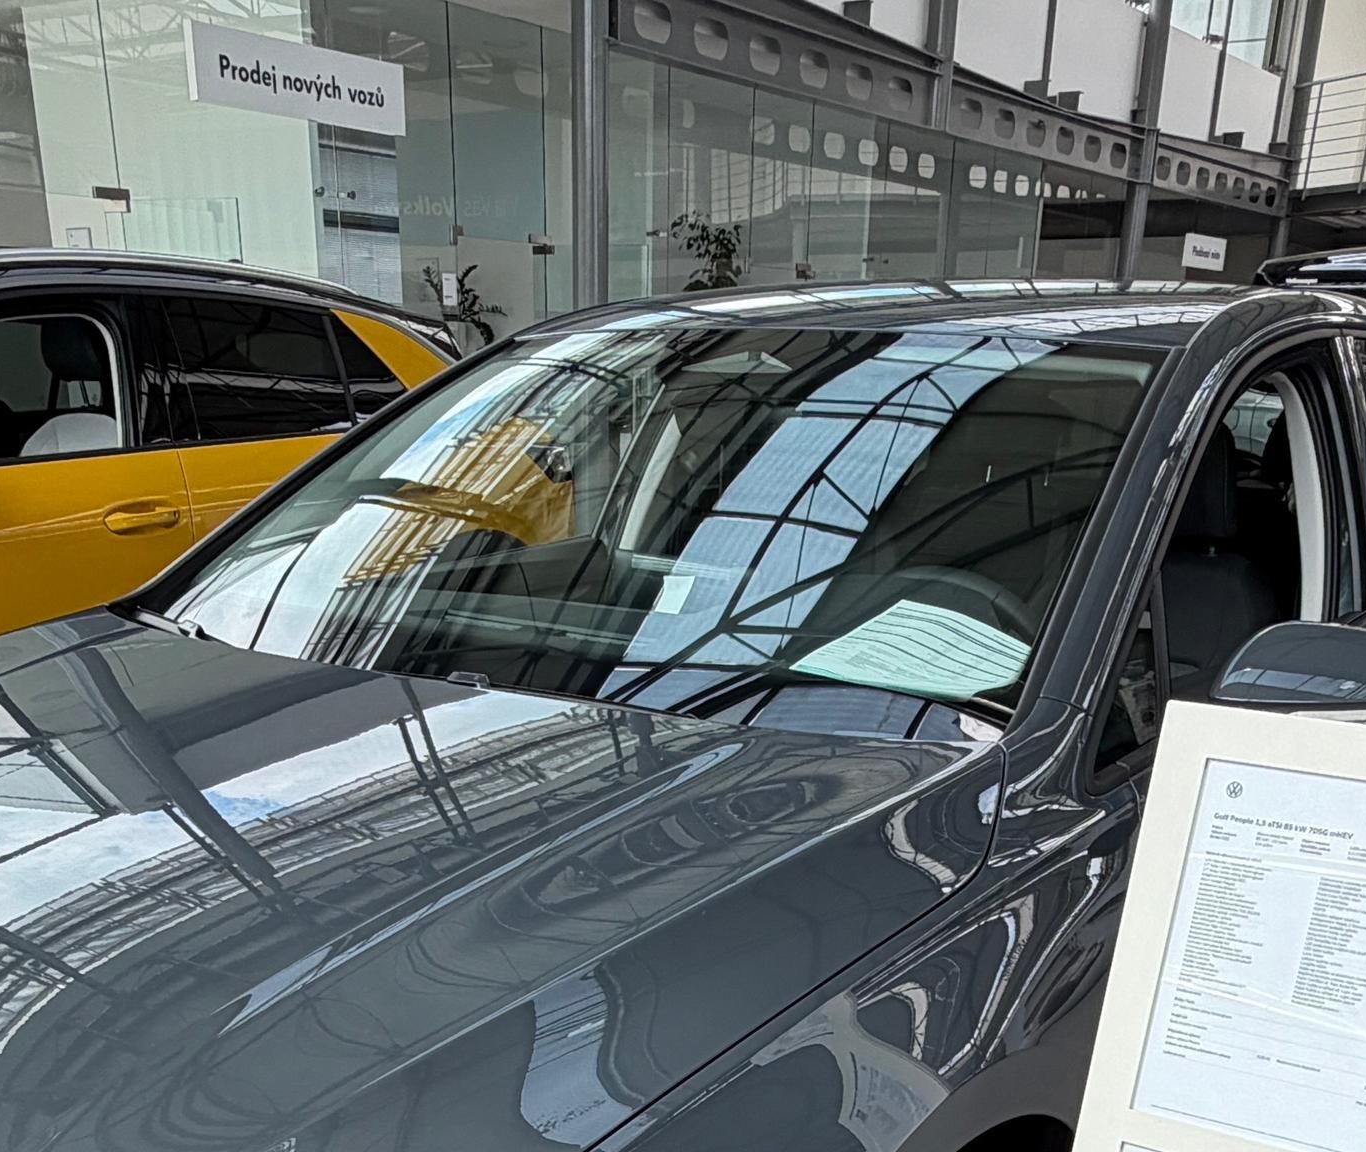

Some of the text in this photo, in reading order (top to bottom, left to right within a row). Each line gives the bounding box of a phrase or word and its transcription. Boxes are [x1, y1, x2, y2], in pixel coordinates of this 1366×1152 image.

[219, 54, 385, 107] Prodej nových vozů
[1214, 813, 1229, 821] Golf
[1230, 815, 1254, 825] People
[1295, 825, 1308, 833] kW
